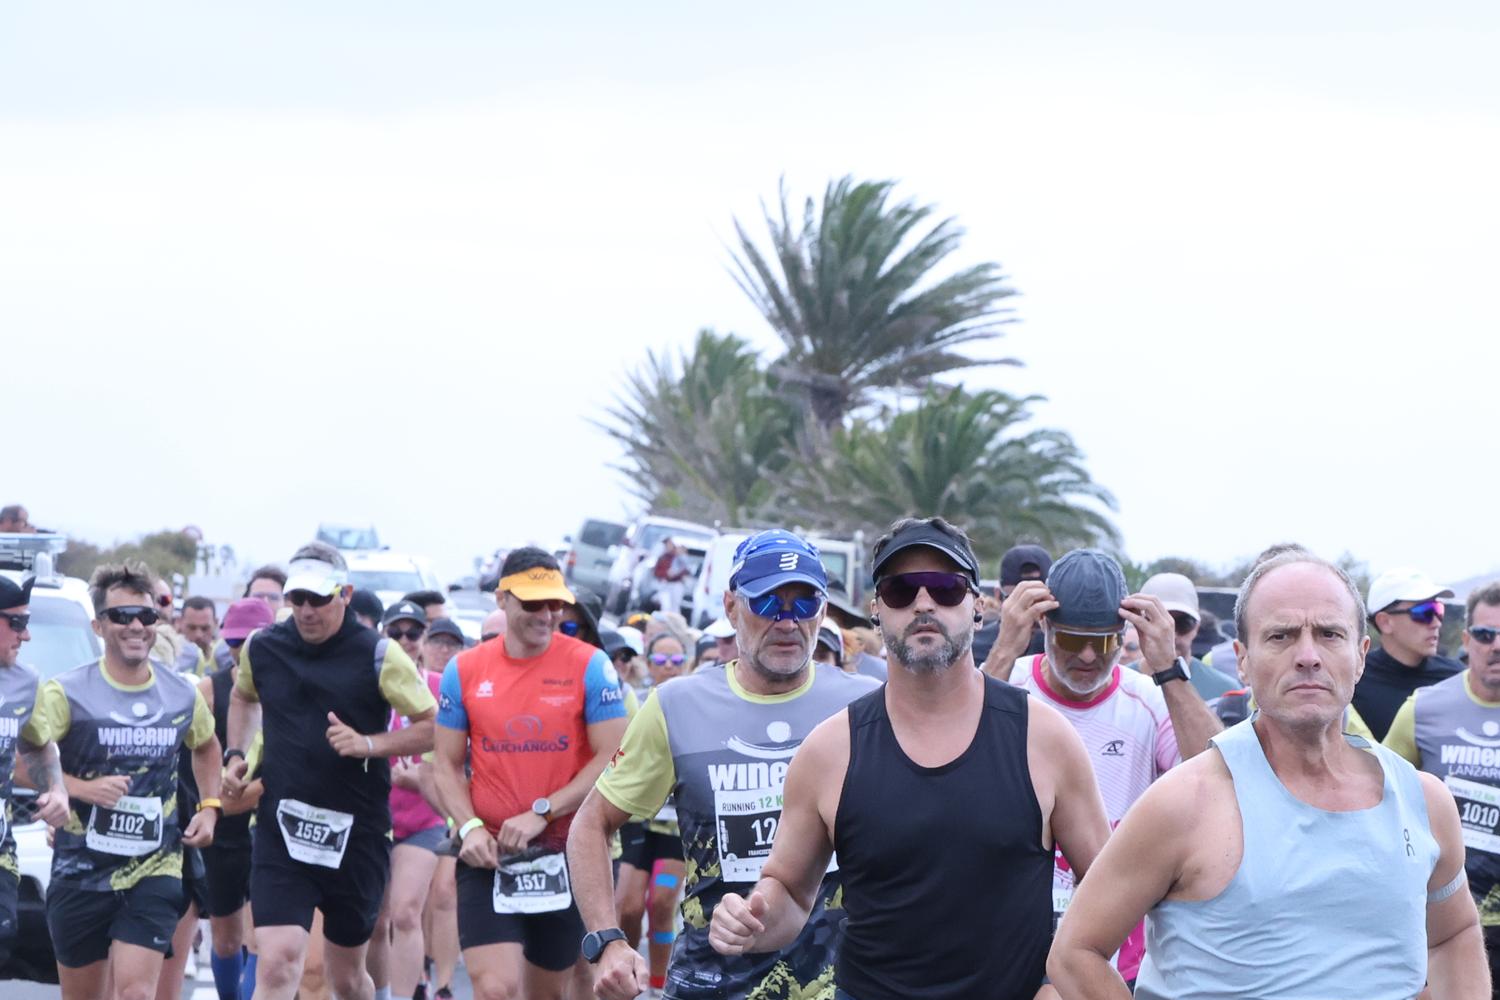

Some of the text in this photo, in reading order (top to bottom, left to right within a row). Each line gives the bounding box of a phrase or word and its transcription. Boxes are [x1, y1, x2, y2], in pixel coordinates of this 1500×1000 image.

[722, 802, 756, 812] RUNNING
[759, 796, 772, 809] 12
[109, 813, 145, 834] 1102
[1461, 802, 1500, 828] 1010
[295, 821, 331, 843] 1557
[751, 817, 778, 846] 12
[515, 873, 547, 891] 1517
